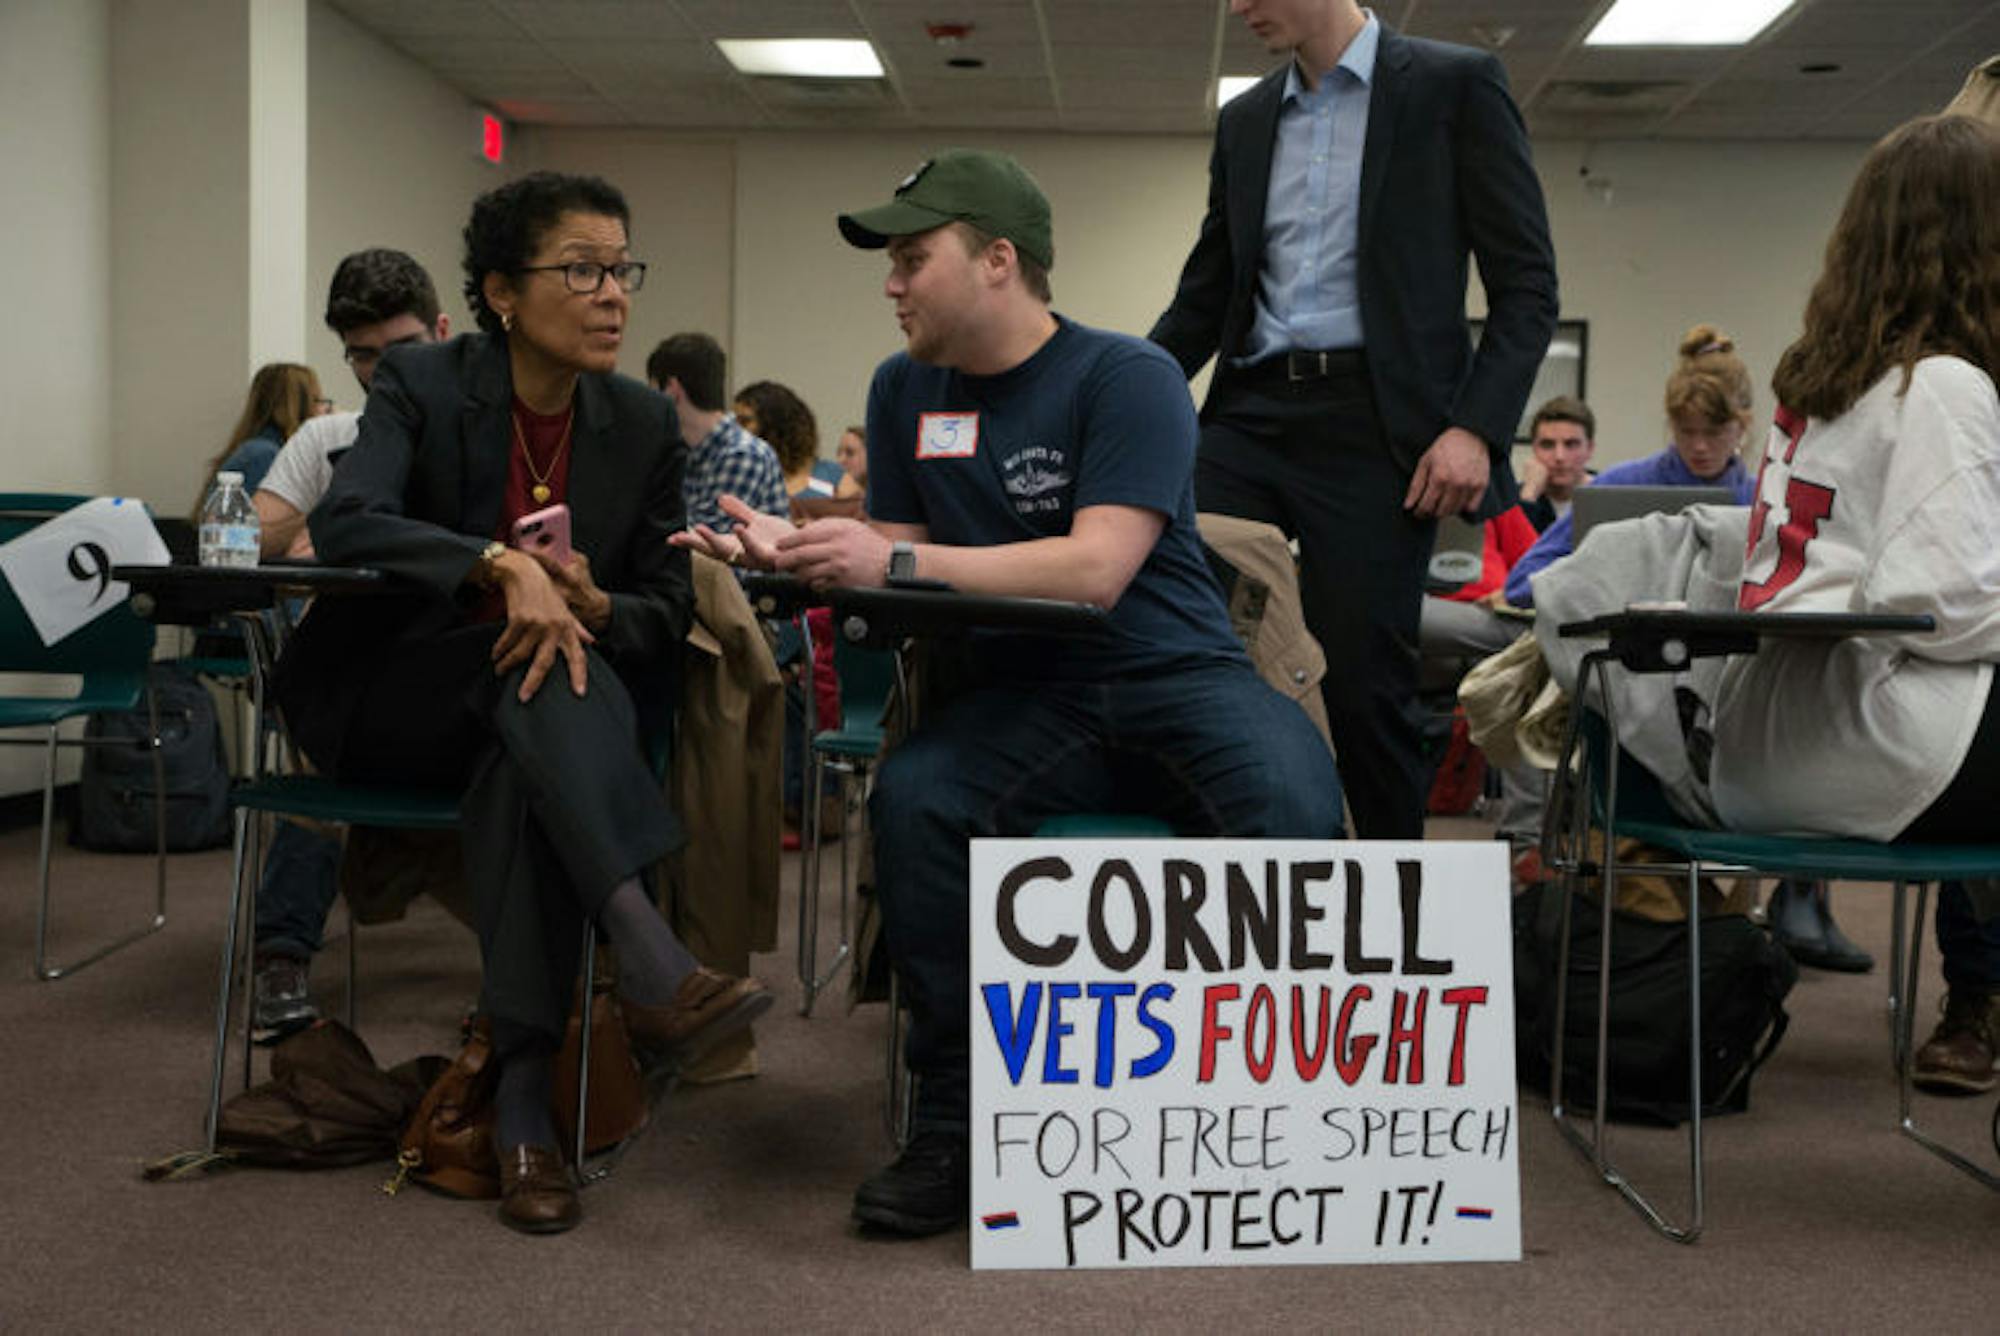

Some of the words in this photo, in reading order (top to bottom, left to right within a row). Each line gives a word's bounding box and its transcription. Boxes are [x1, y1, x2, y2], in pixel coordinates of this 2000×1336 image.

[930, 418, 961, 450] 3
[66, 541, 111, 607] 9
[995, 856, 1453, 975] CORNELL
[980, 981, 1177, 1089] VETS
[1196, 983, 1490, 1087] FOUGHT
[993, 1110, 1132, 1180] FOR
[1159, 1105, 1290, 1179] FREE
[1321, 1105, 1511, 1162] SPEECH
[1060, 1187, 1344, 1267] PROTECT
[1374, 1180, 1445, 1247] IT!
